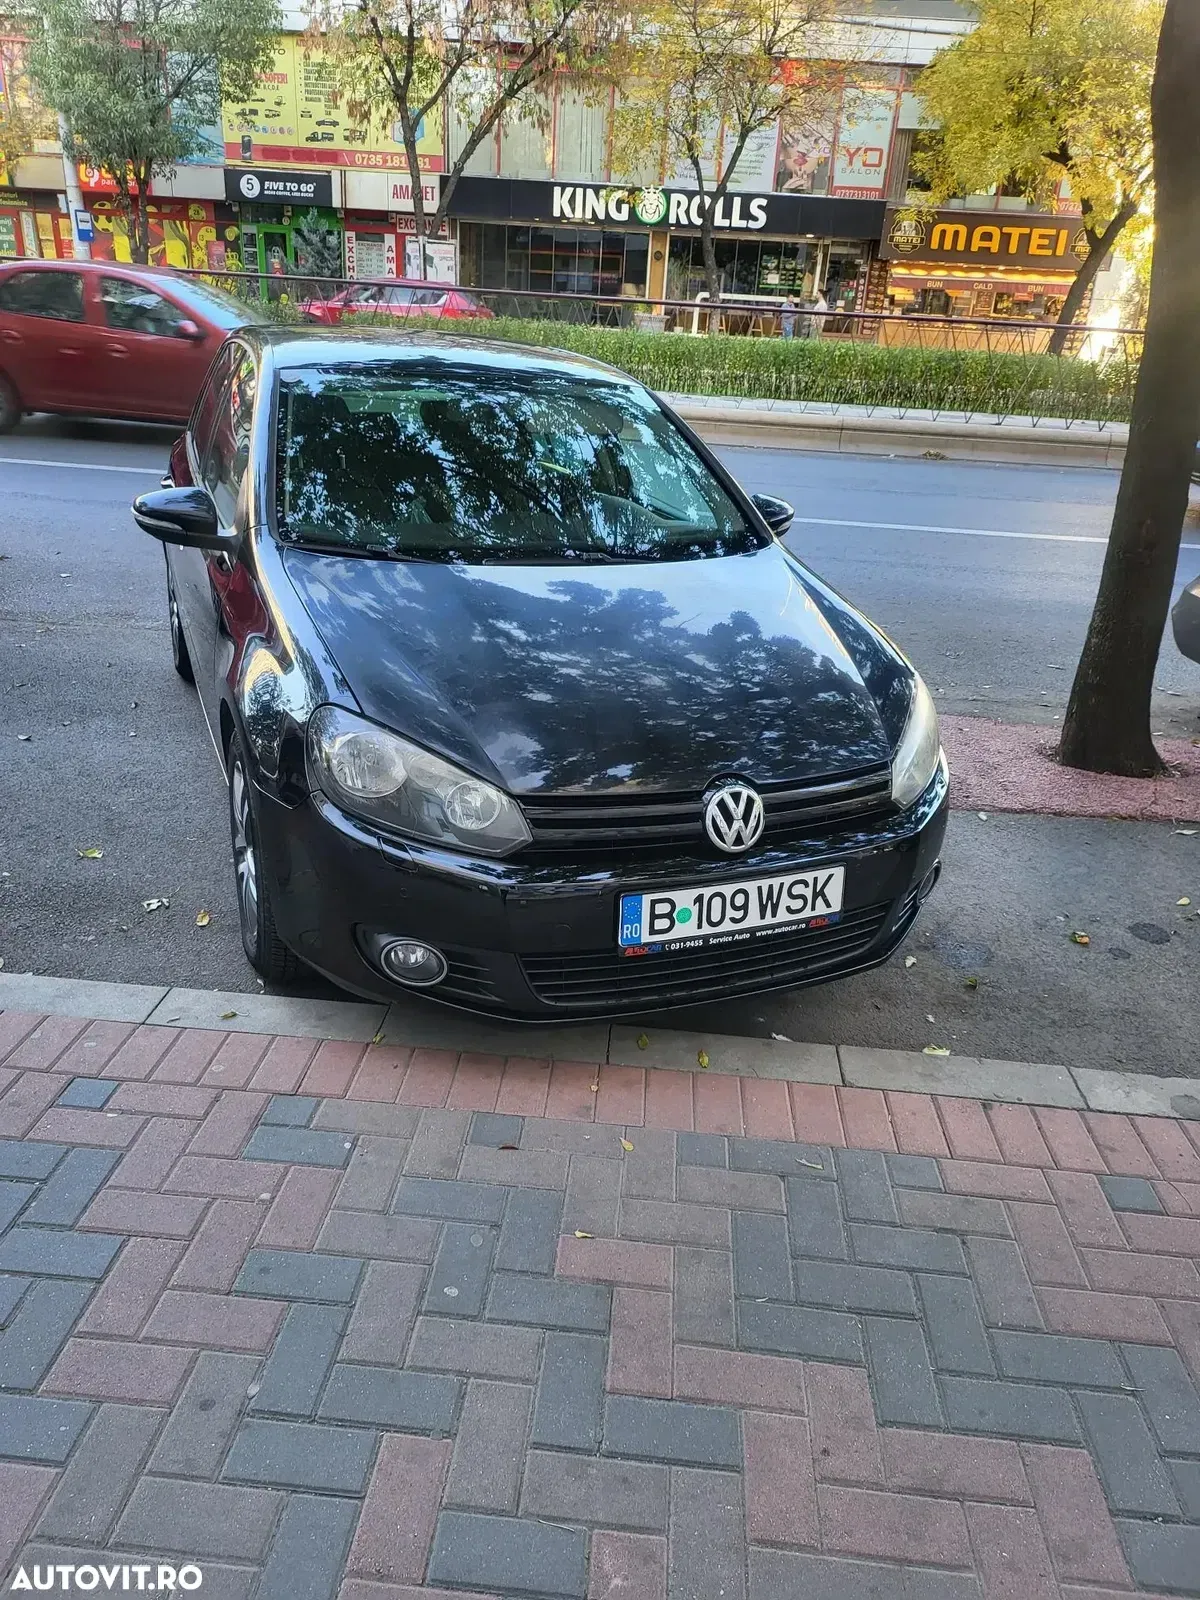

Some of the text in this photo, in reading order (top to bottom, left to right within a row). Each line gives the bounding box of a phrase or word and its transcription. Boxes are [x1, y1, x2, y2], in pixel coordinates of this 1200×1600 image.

[355, 153, 383, 166] 0735
[386, 155, 407, 167] 181
[841, 167, 881, 176] SALON
[264, 181, 284, 191] FIVE
[285, 182, 299, 191] TO
[552, 186, 630, 222] KING
[668, 193, 768, 229] ROLLS
[893, 236, 921, 244] MATEI
[930, 223, 1068, 256] MATEI
[926, 281, 943, 289] BUN
[623, 873, 835, 939] RO B 109 WSK
[670, 939, 703, 950] 031-9455
[709, 932, 733, 945] Service
[733, 931, 751, 942] Auto
[756, 922, 807, 937] www.autocar.ro
